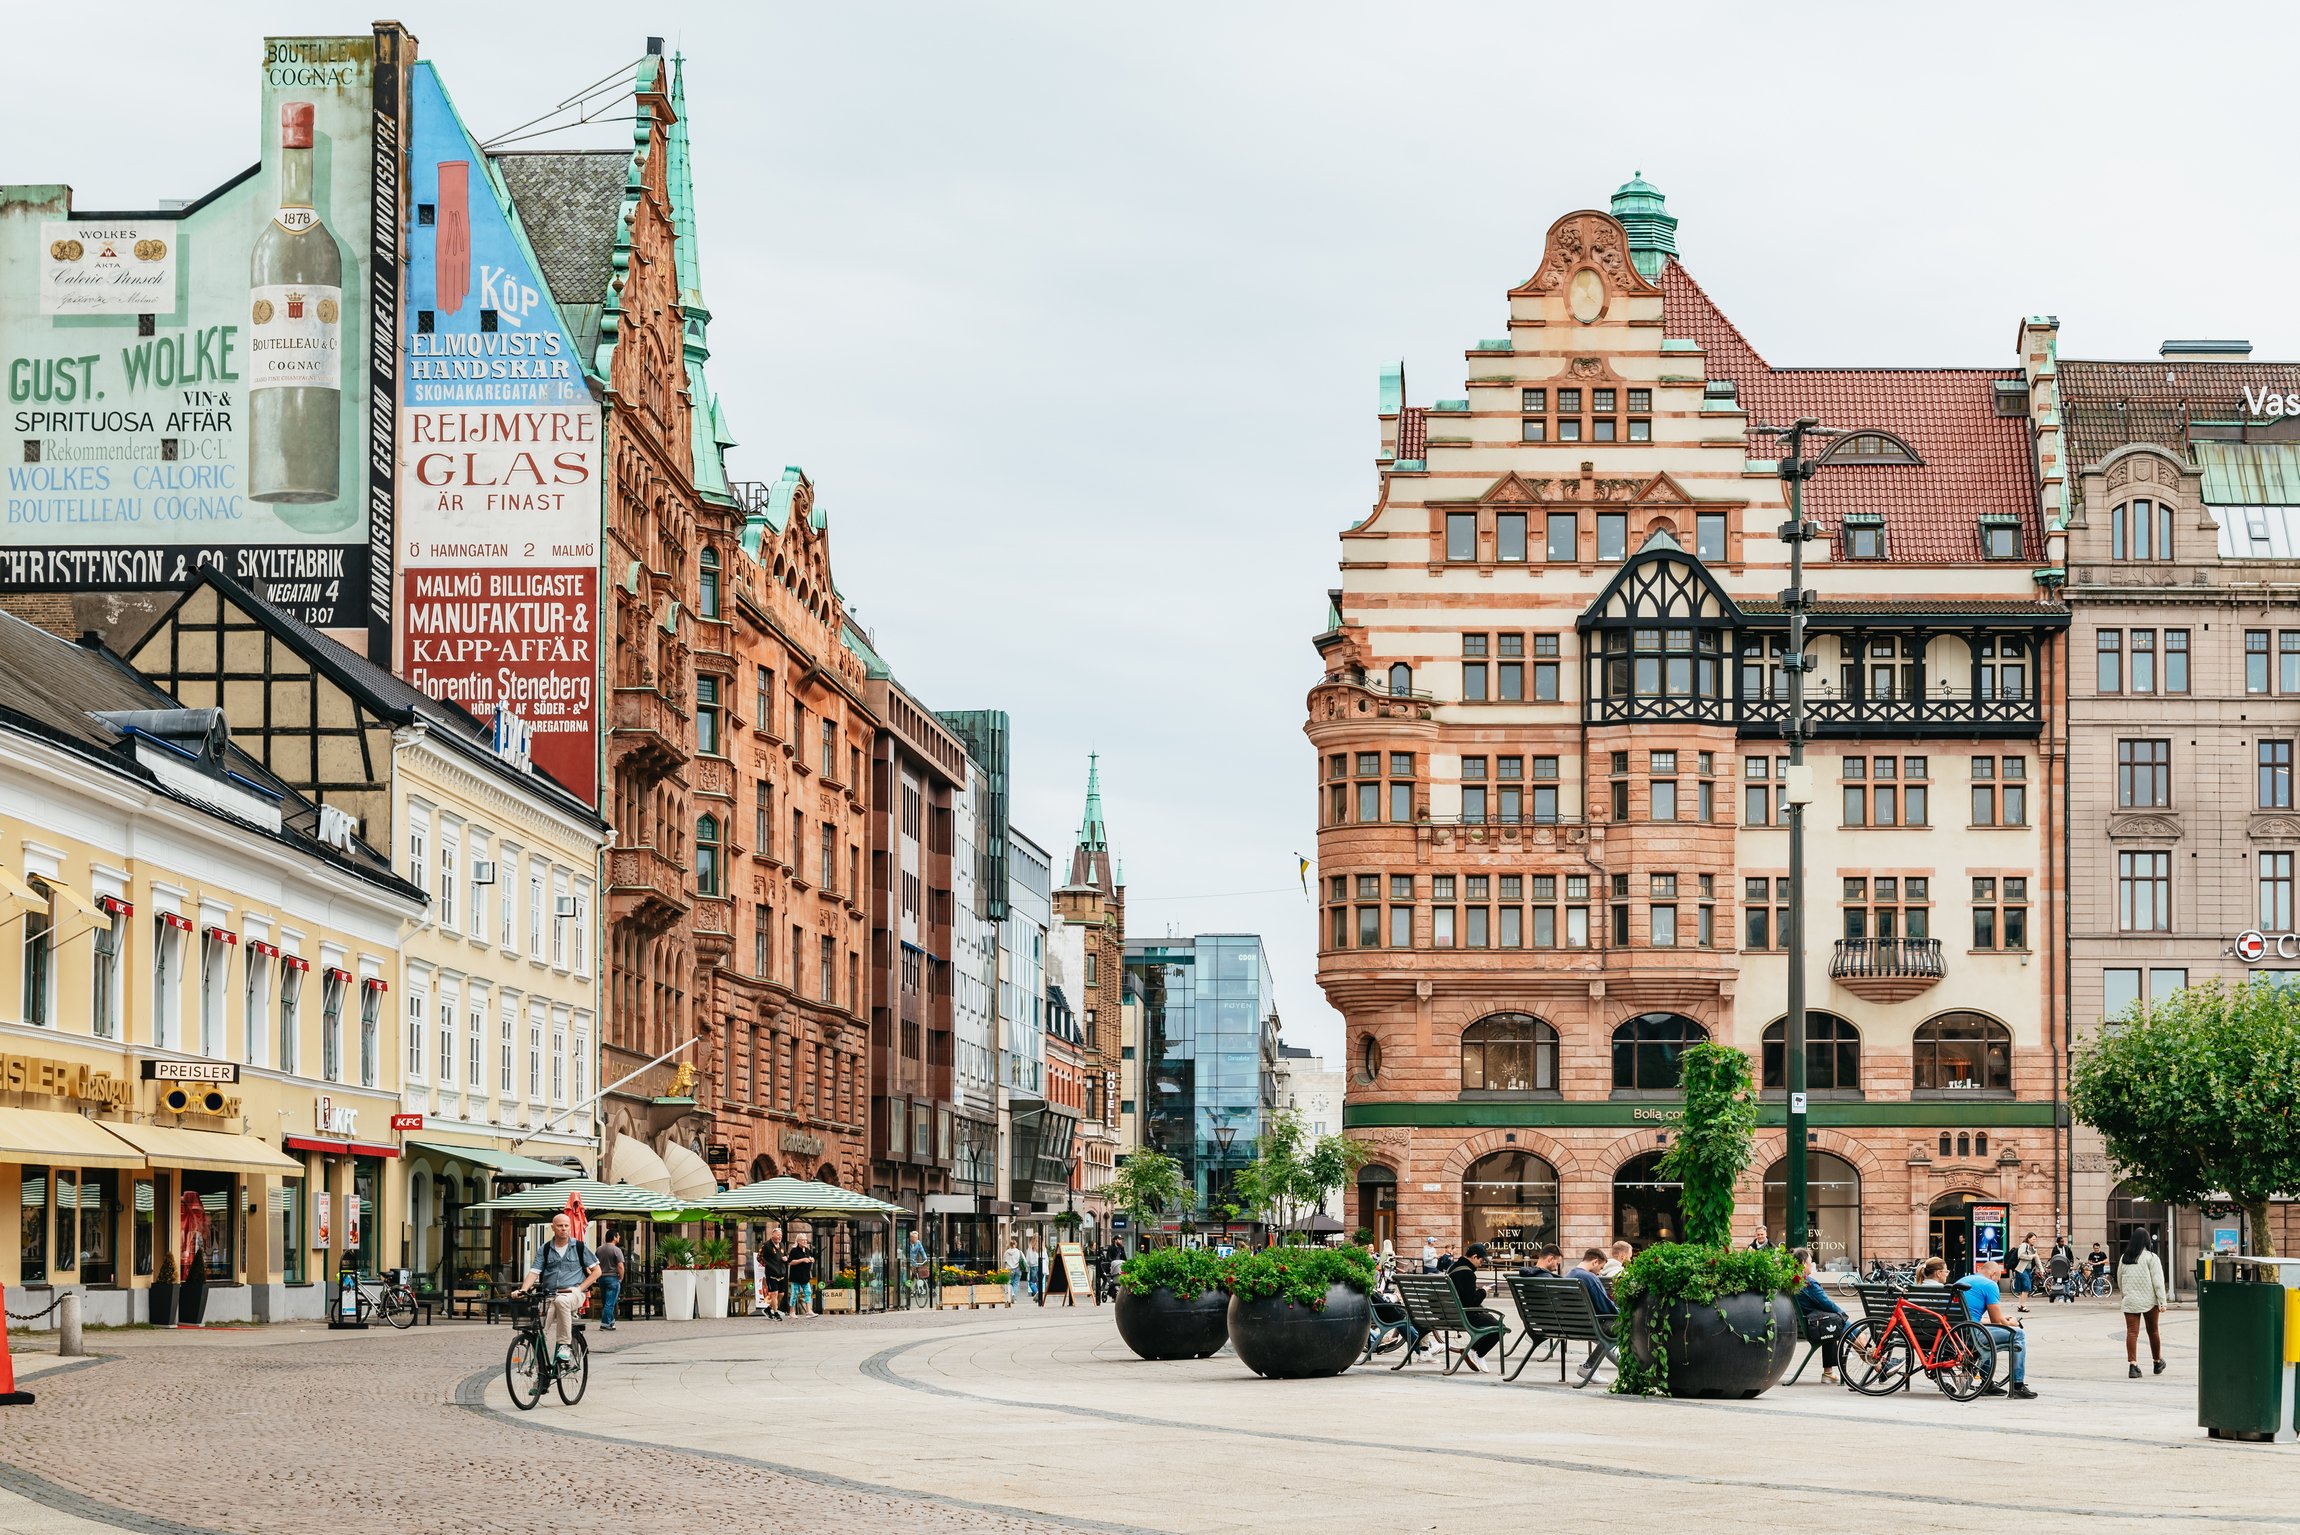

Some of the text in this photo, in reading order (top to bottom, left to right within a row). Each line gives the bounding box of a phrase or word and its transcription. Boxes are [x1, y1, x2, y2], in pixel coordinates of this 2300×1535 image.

[268, 44, 367, 64] BOUTELLE
[269, 67, 353, 86] COGNAC
[374, 108, 396, 266] ANNONSBYRÅ
[283, 212, 311, 225] 1878
[79, 230, 137, 239] WOLKES
[480, 265, 539, 328] KÖP
[253, 338, 320, 351] BOUTELLEAU
[411, 331, 561, 358] ELMQVIST'S
[9, 324, 239, 402] GUST. WOLKE
[268, 360, 322, 371] COGNAC
[411, 359, 569, 380] HANDSKAR
[416, 381, 582, 401] SKOMAKAREGATAN 16.
[15, 409, 232, 432] SPIRITUOSA AFFÄR
[372, 384, 393, 479] GENOM
[412, 413, 595, 443] REIJMYRE
[8, 464, 235, 491] WOLKES CALORIC
[416, 452, 589, 487] GLAS
[8, 495, 243, 523] BOUTELLEAU COGNAC
[438, 491, 565, 511] ÄR FINAST
[371, 485, 391, 625] ANNONSERA
[410, 542, 594, 557] Ö HAMNGATAN 2 MALMÖ
[0, 550, 163, 583] CHRISTENSON
[169, 554, 187, 582] &
[237, 549, 344, 578] SKYLTFABRIK
[266, 580, 339, 602] NEGATAN 4
[416, 572, 584, 597] MALMÖ BILLIGASTE
[305, 607, 334, 624] 1307
[409, 602, 590, 634] MANUFAKTUR-&
[412, 636, 591, 662] KAPP-AFFÄR
[413, 667, 590, 710] Florentin Steneberg
[471, 701, 510, 715] HÖRN
[515, 703, 527, 715] AF
[0, 1052, 70, 1097] ISLER
[160, 1064, 231, 1079] PREISLER
[1106, 1071, 1116, 1128] HOTELL
[396, 1118, 421, 1126] KFC
[1497, 1229, 1521, 1238] NEW
[1808, 1229, 1824, 1238] EW
[1481, 1241, 1543, 1250] OLLECTION
